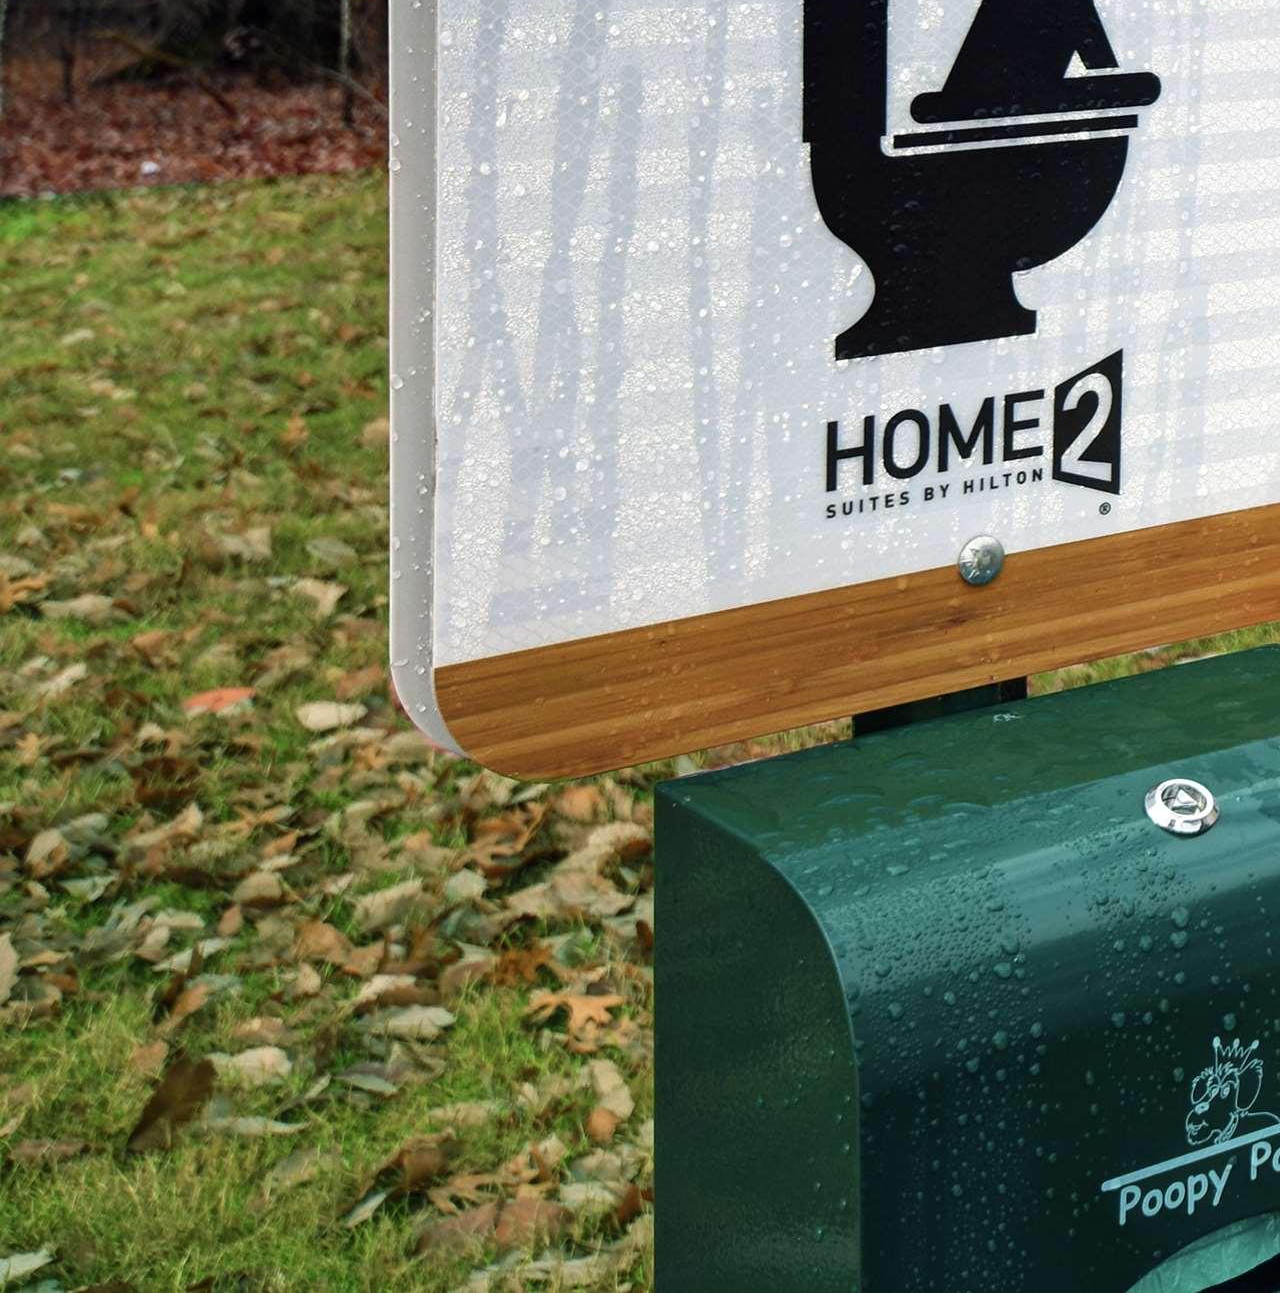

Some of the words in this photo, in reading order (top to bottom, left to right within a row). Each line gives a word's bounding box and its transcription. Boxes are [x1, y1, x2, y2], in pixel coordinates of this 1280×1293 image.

[826, 491, 909, 519] SUITES
[924, 484, 950, 501] BY
[963, 468, 1044, 494] HILTON
[1119, 1156, 1236, 1226] Poopy
